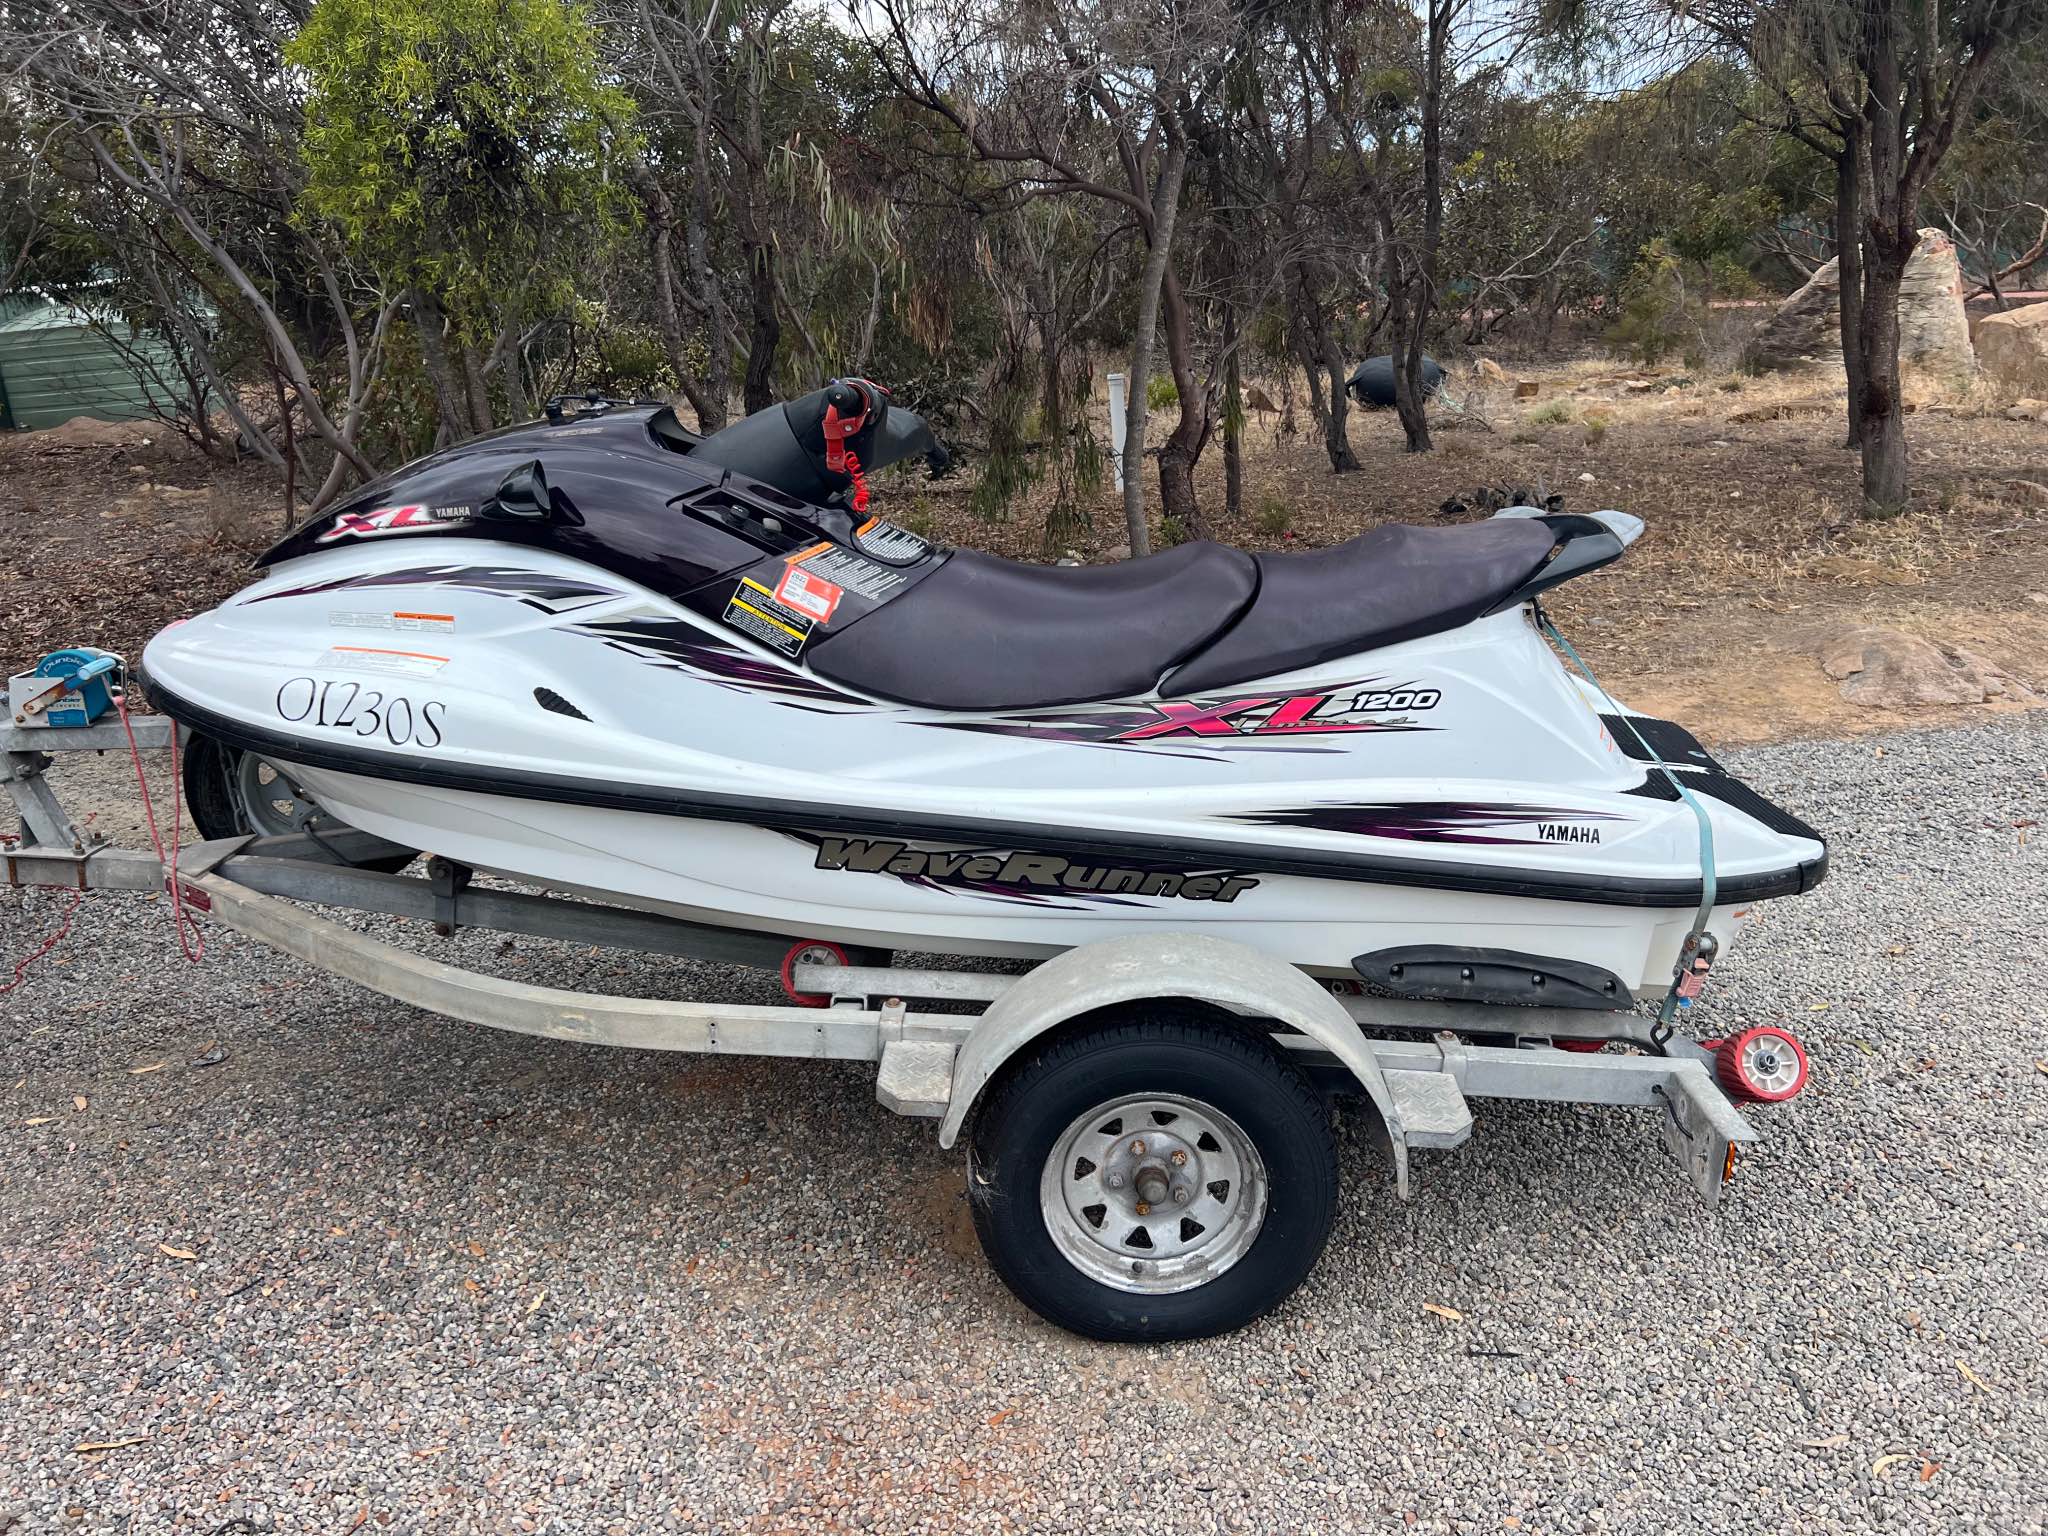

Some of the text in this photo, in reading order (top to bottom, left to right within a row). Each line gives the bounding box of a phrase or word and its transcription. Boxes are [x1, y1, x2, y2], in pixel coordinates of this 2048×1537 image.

[435, 506, 471, 518] YAMAHA
[43, 656, 84, 673] Dunbie
[1108, 689, 1442, 742] XL 1200
[1537, 823, 1600, 844] YAMAHA
[814, 835, 1261, 904] WaveRunner
